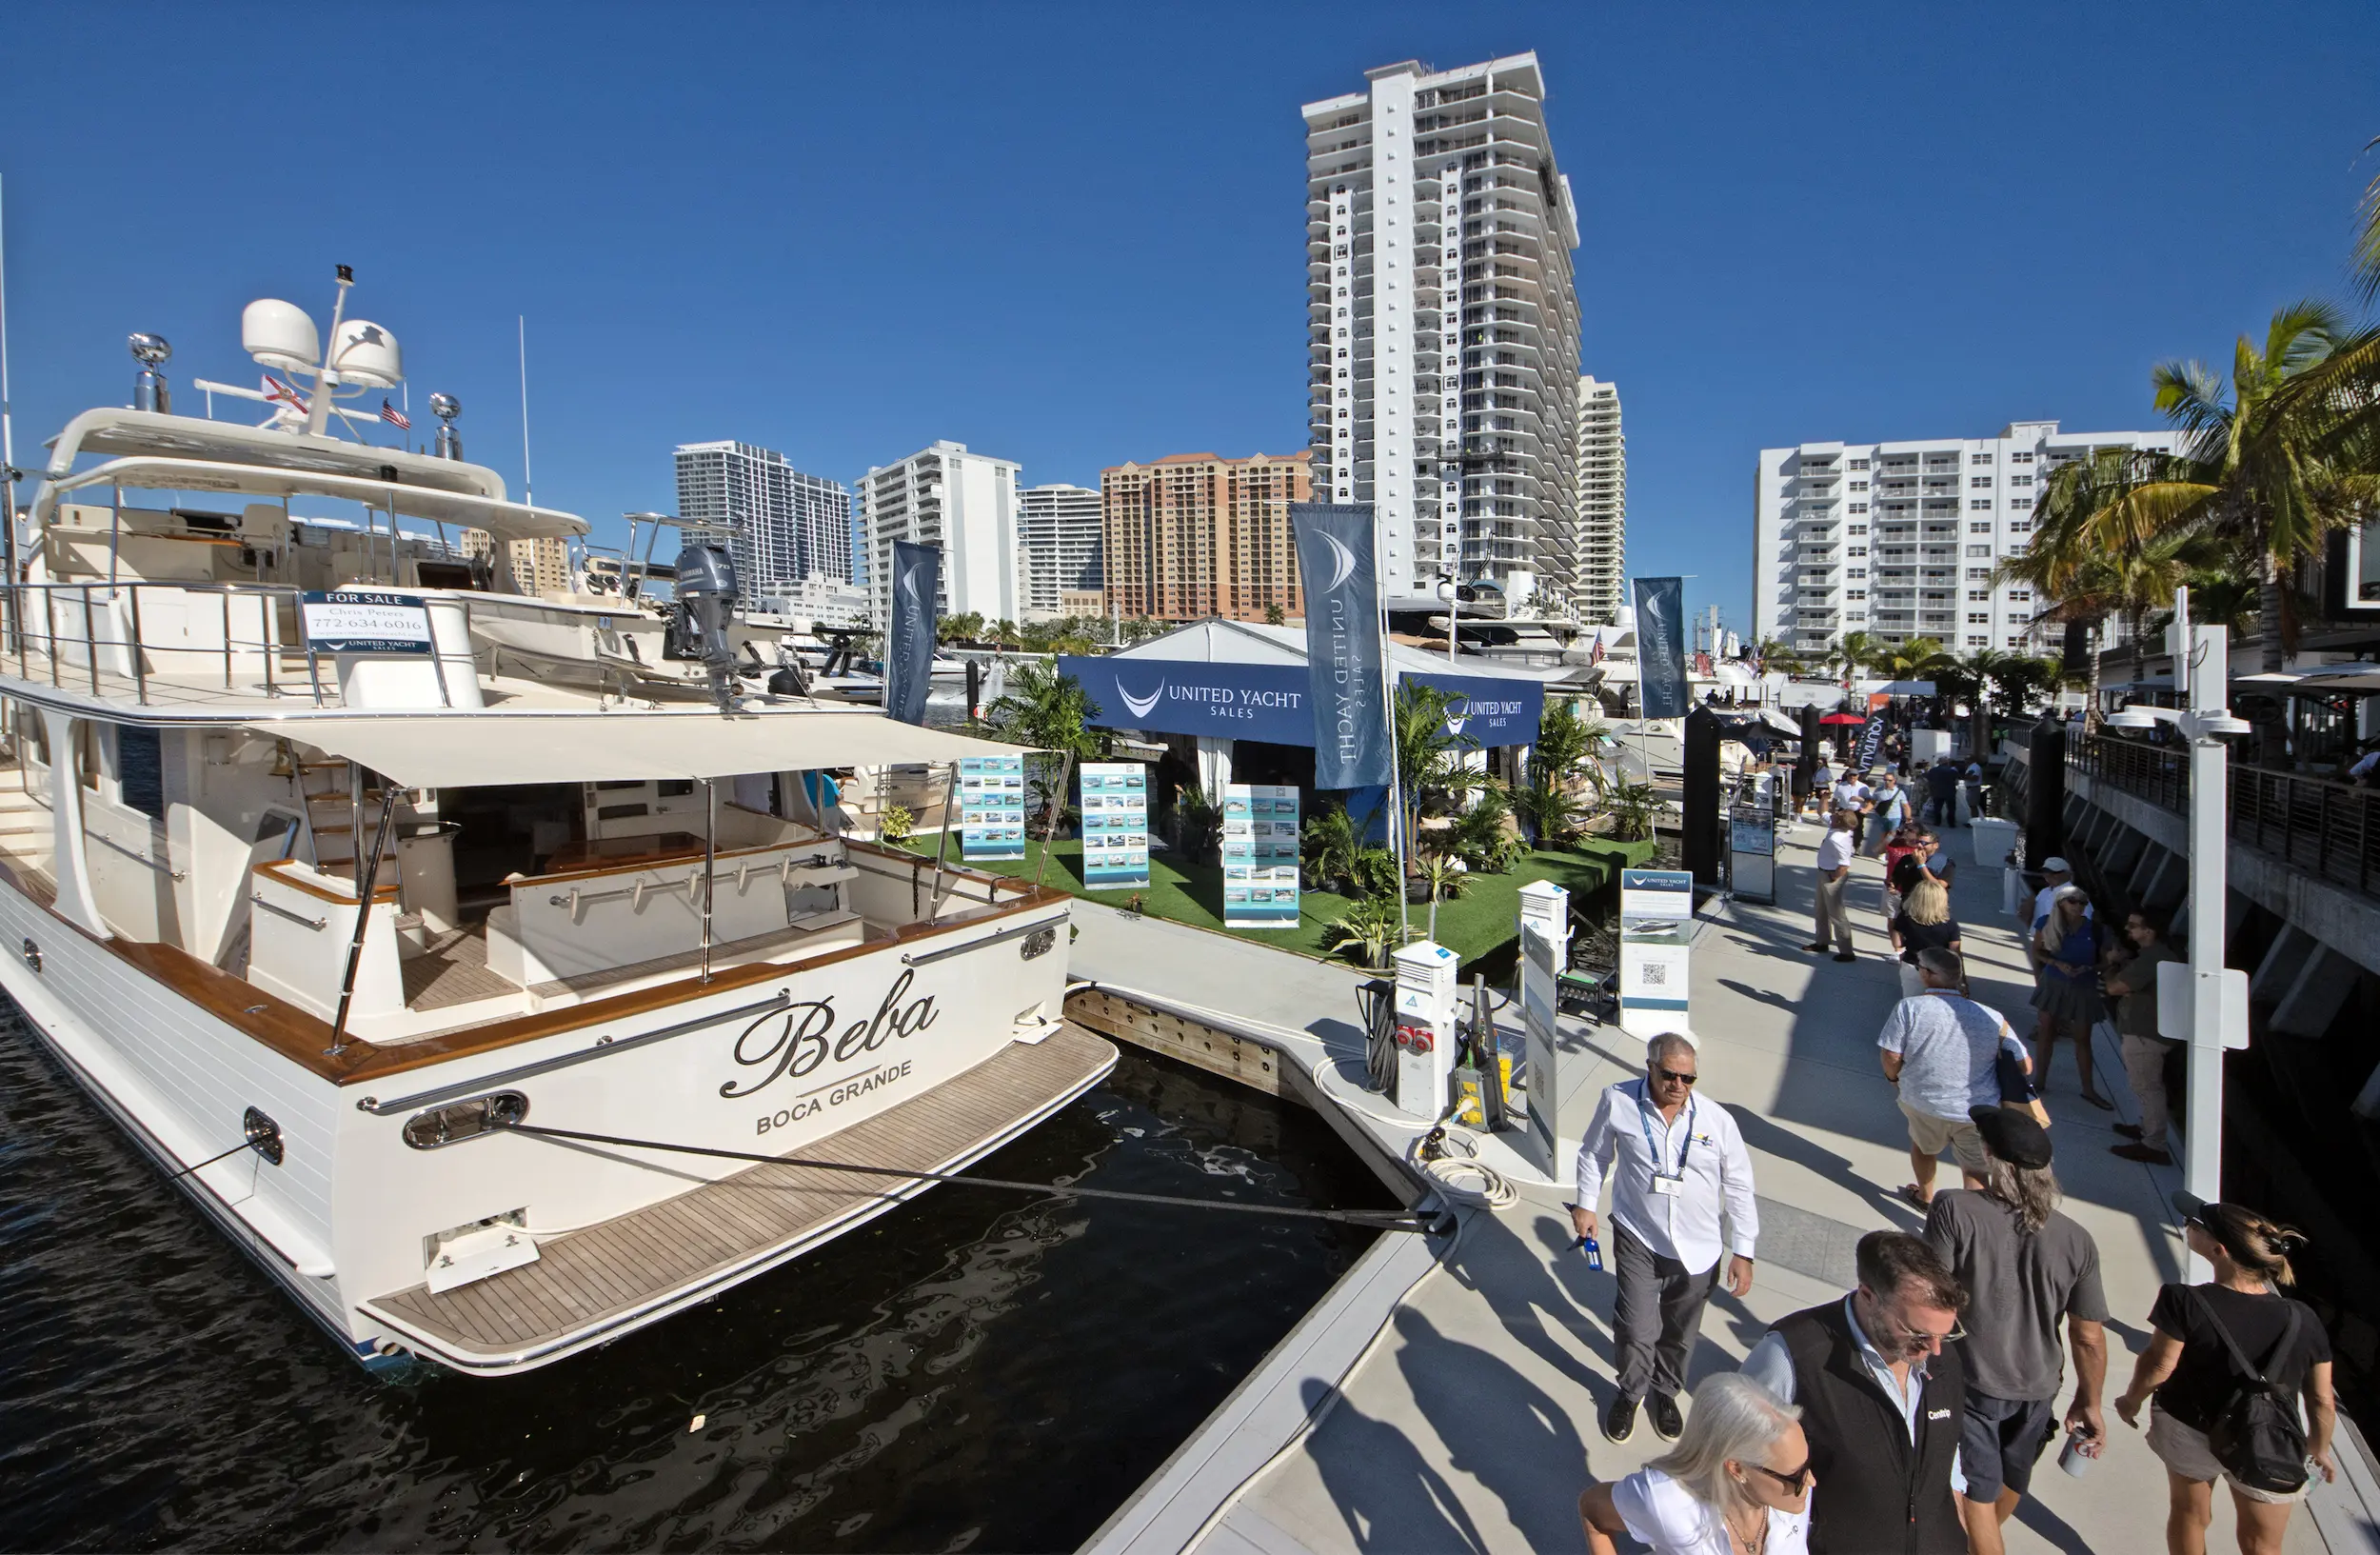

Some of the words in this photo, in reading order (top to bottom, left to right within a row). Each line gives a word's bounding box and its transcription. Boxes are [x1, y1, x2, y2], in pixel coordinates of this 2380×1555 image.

[326, 593, 359, 603] FOR
[365, 594, 403, 605] SALE
[329, 608, 363, 616] Chris
[367, 608, 404, 617] Peters
[313, 618, 422, 629] 772-634-6016
[902, 606, 921, 662] UNITED
[1657, 624, 1670, 667] UNITED
[1169, 686, 1234, 703] UNITED
[1240, 689, 1301, 708] YACHT
[1661, 670, 1673, 708] YACHT
[1210, 706, 1254, 719] SALES
[1471, 701, 1499, 715] UNITED
[1500, 701, 1522, 714] YACHT
[1489, 718, 1506, 728] SALES
[719, 967, 940, 1099] Beba
[757, 1098, 823, 1136] BOCA
[829, 1060, 913, 1106] GRANDE
